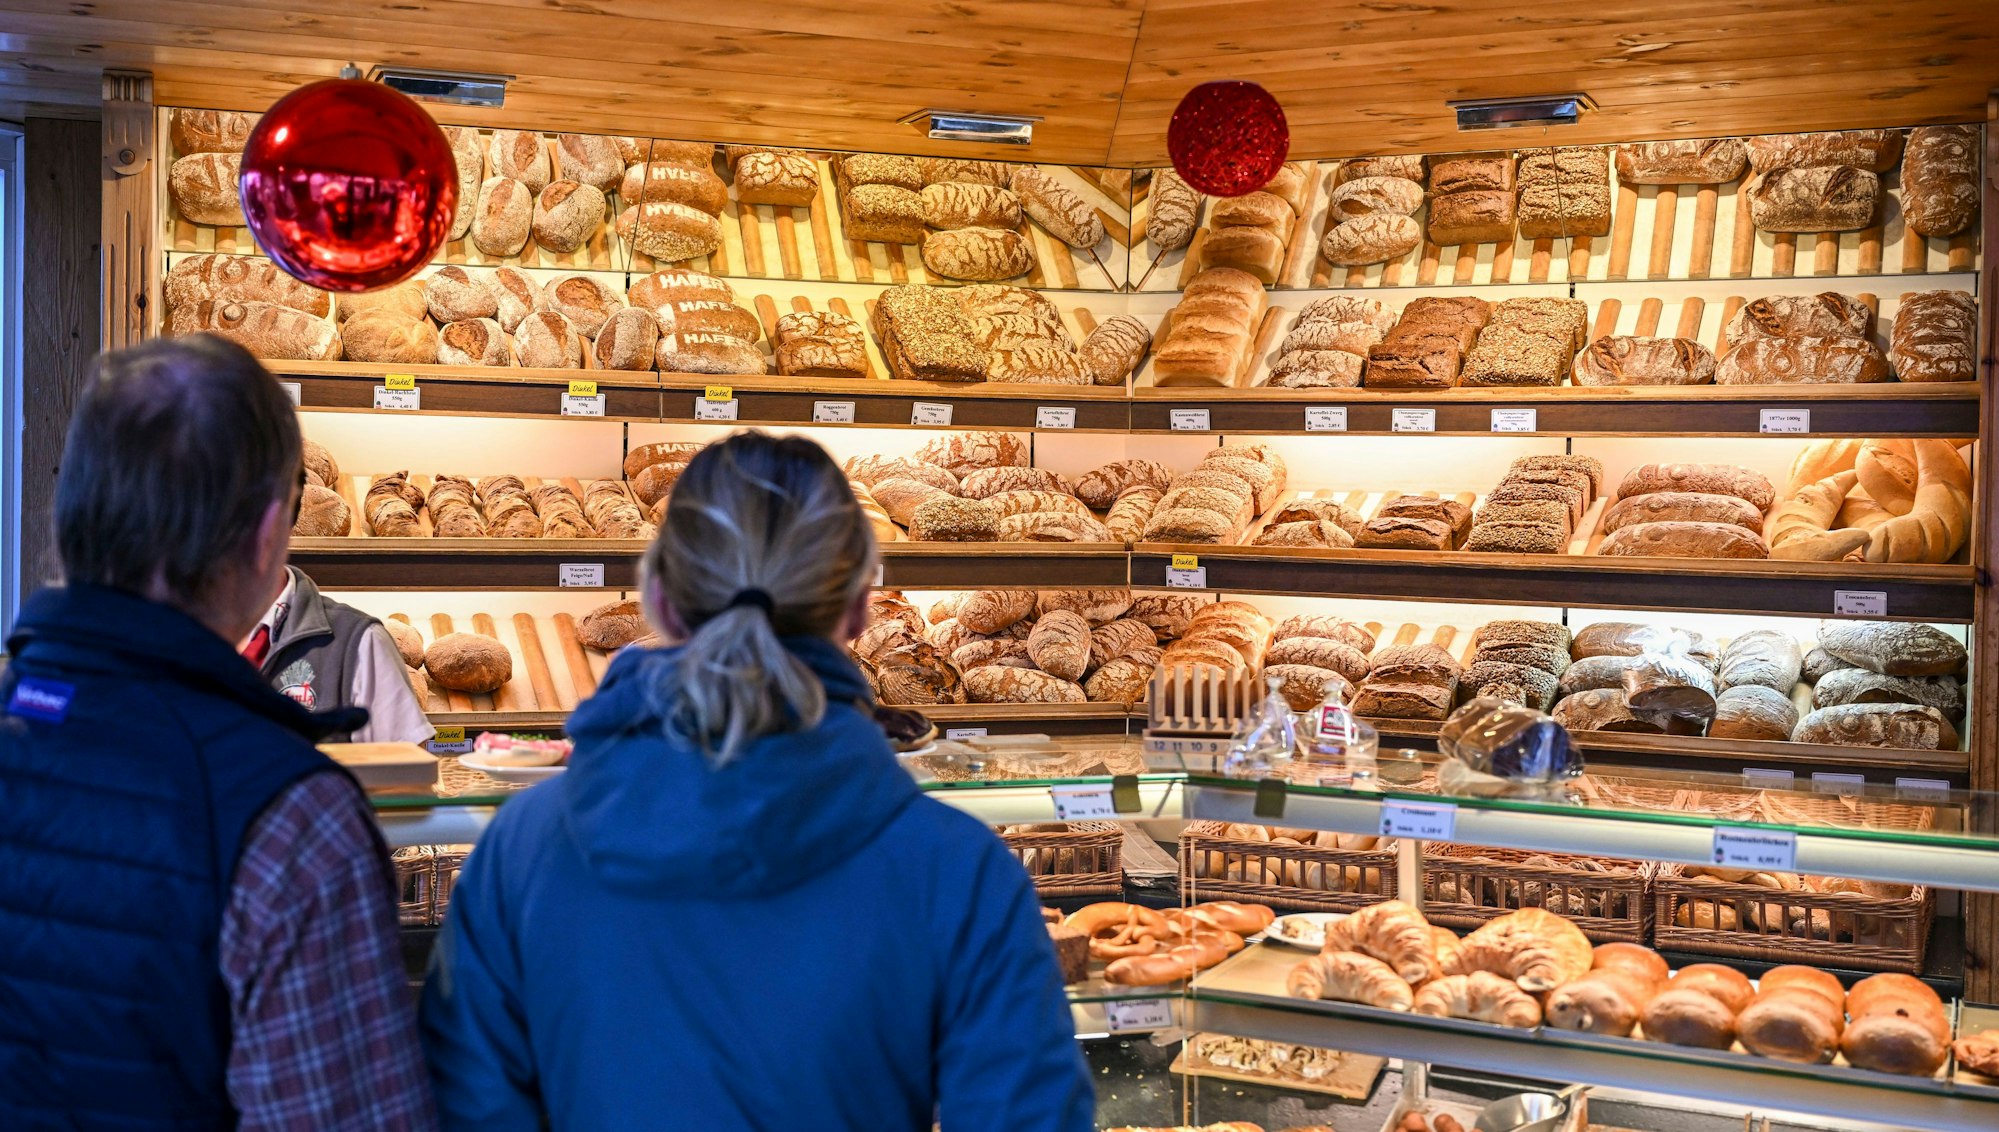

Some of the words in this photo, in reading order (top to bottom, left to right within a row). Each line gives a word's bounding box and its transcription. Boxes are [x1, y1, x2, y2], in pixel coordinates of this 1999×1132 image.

[389, 378, 411, 386] Dinkel
[572, 384, 594, 393] Dinkel
[708, 389, 729, 398] Dinkel
[656, 443, 707, 456] HAFE
[1175, 558, 1196, 566] Dinkel
[438, 730, 462, 739] Dinkel
[1154, 741, 1166, 751] 12
[1172, 742, 1183, 751] 11
[1192, 742, 1203, 751] 10
[1210, 743, 1218, 752] 9
